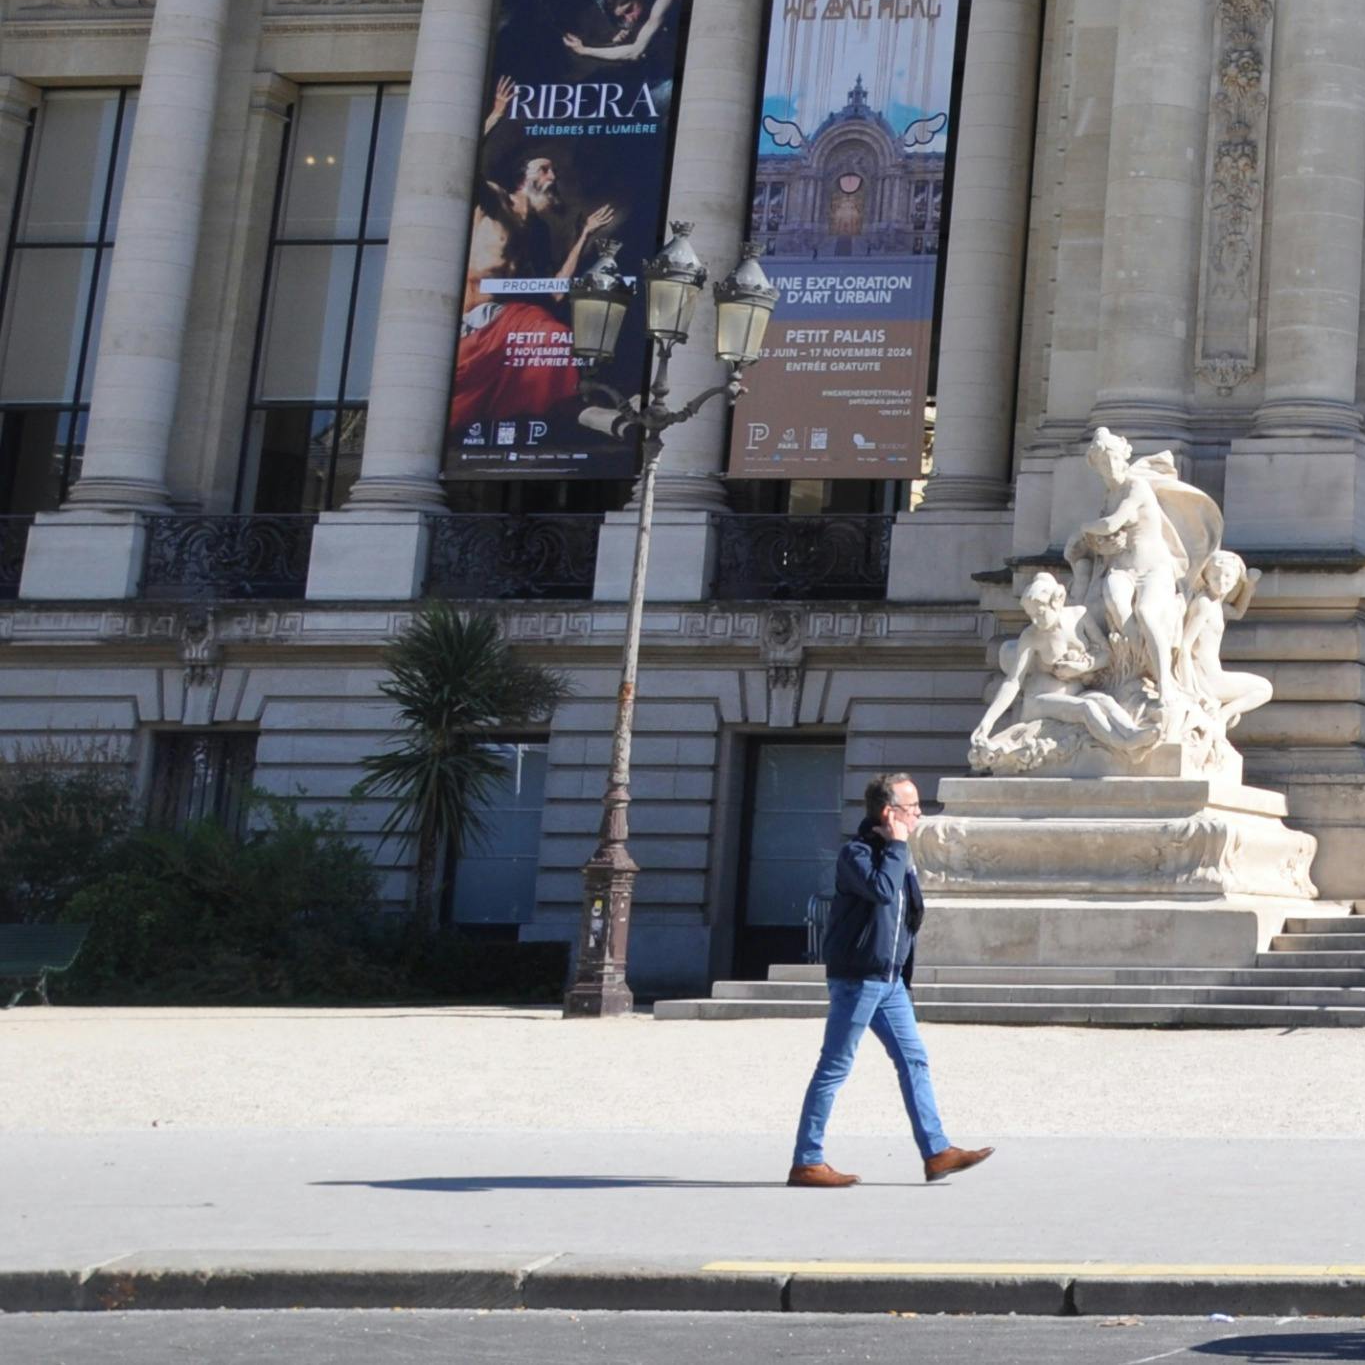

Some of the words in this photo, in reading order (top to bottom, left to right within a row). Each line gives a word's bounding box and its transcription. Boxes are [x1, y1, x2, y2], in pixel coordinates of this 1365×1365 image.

[509, 82, 660, 120] RIBERA
[525, 125, 584, 136] TÉNÈBRES
[588, 125, 602, 135] ET
[605, 123, 657, 134] LUMIÈRE
[502, 280, 569, 292] PROCHAIN
[806, 276, 912, 290] EXPLORATION
[787, 291, 831, 304] D'ART
[834, 290, 892, 303] URBAIN
[506, 332, 545, 344] PETIT
[551, 331, 574, 344] PAL
[786, 329, 829, 343] PETIT
[833, 329, 886, 343] PALAIS
[514, 346, 570, 356] NOVEMBRE
[772, 348, 797, 357] JUIN
[810, 349, 821, 357] 17
[823, 348, 884, 357] NOVEMBRE
[887, 348, 913, 357] 2024
[527, 356, 568, 366] FÉVRIER
[786, 361, 827, 372] ENTRÉE
[830, 362, 881, 372] GRATUITE
